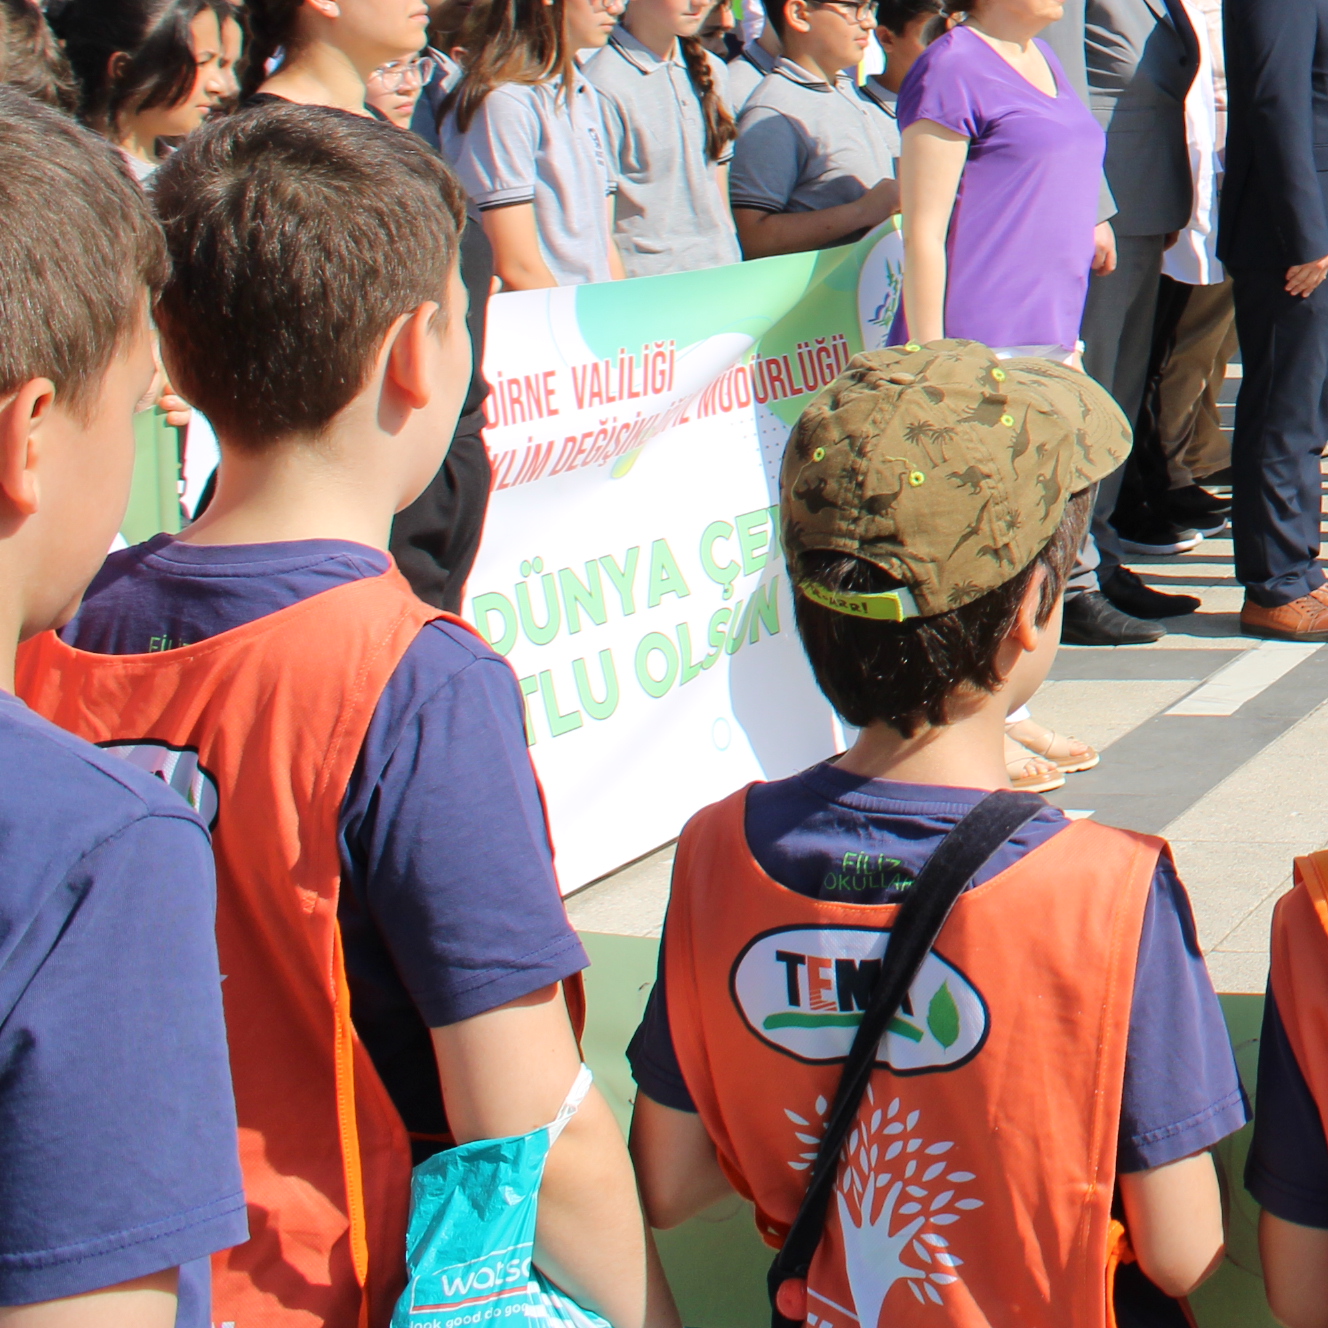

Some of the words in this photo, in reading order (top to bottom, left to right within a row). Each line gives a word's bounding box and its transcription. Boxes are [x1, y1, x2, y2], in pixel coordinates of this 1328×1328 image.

[571, 339, 676, 410] VALİLİĞİ
[697, 333, 851, 419] MÜDÜRLÜĞÜ
[472, 538, 691, 658] DÜNYA
[635, 574, 780, 699] OLSUN
